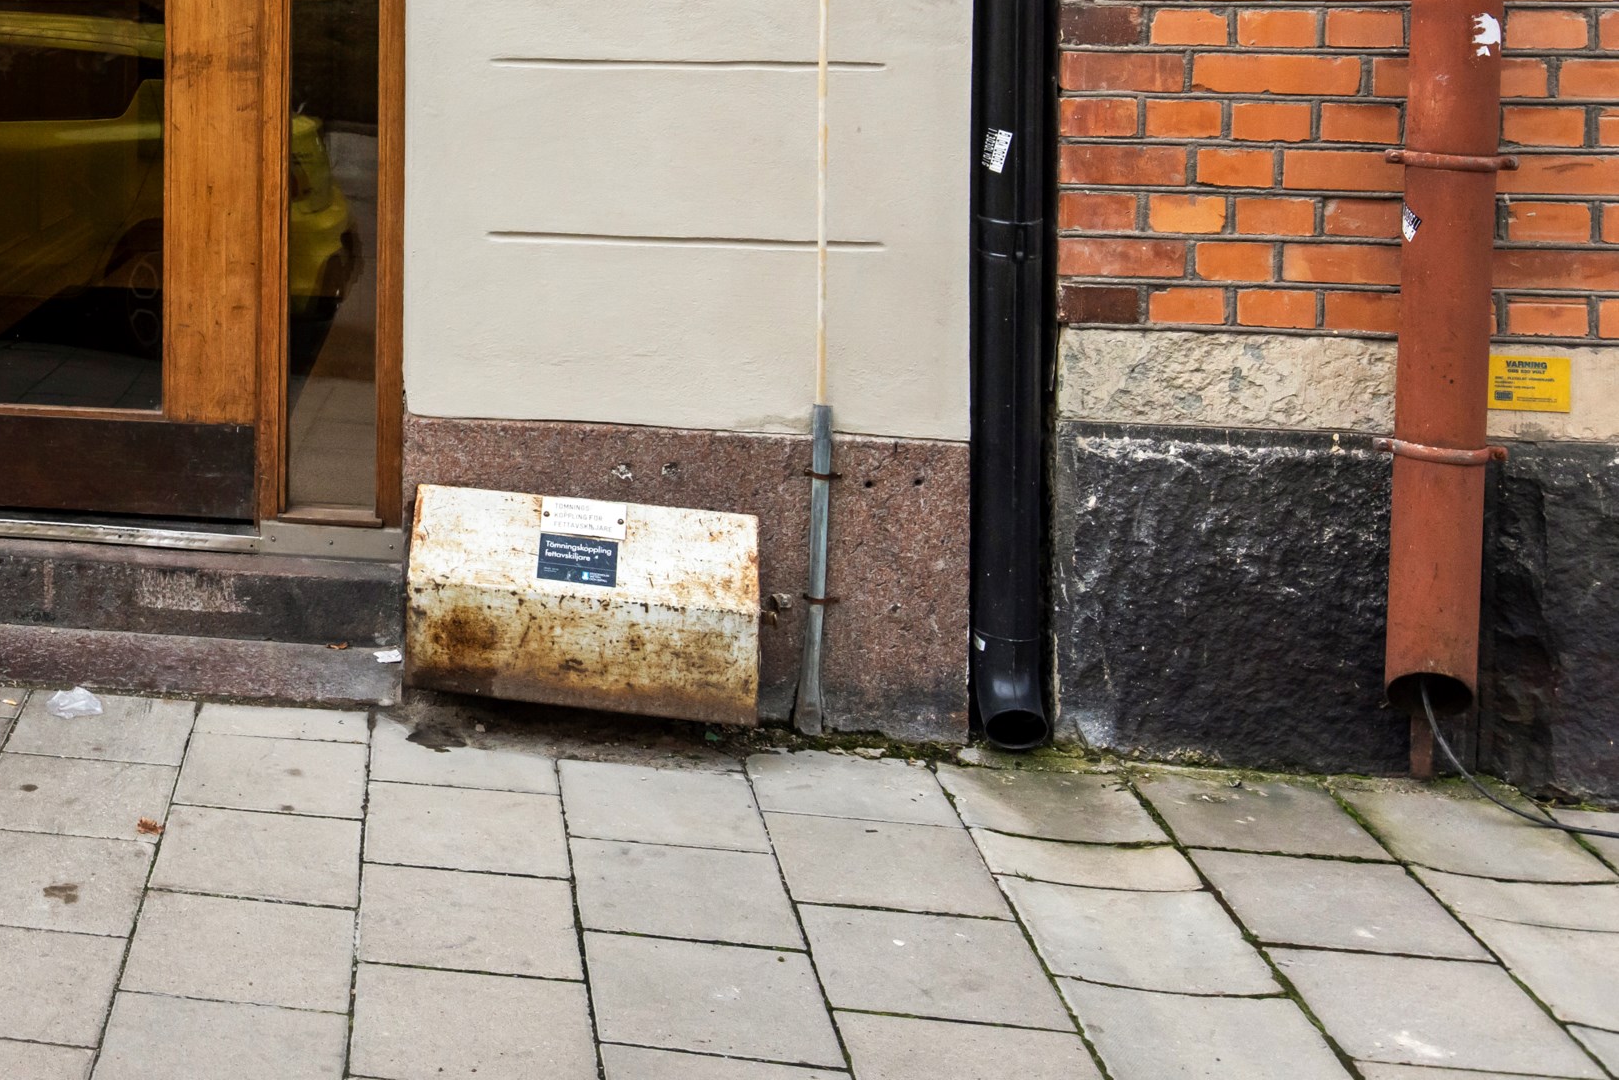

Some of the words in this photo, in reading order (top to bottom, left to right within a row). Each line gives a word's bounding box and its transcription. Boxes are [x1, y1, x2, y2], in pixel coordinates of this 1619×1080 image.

[1506, 360, 1548, 369] VARNING
[545, 540, 612, 557] Tömningskoppling
[544, 549, 591, 562] fettavskiljare
